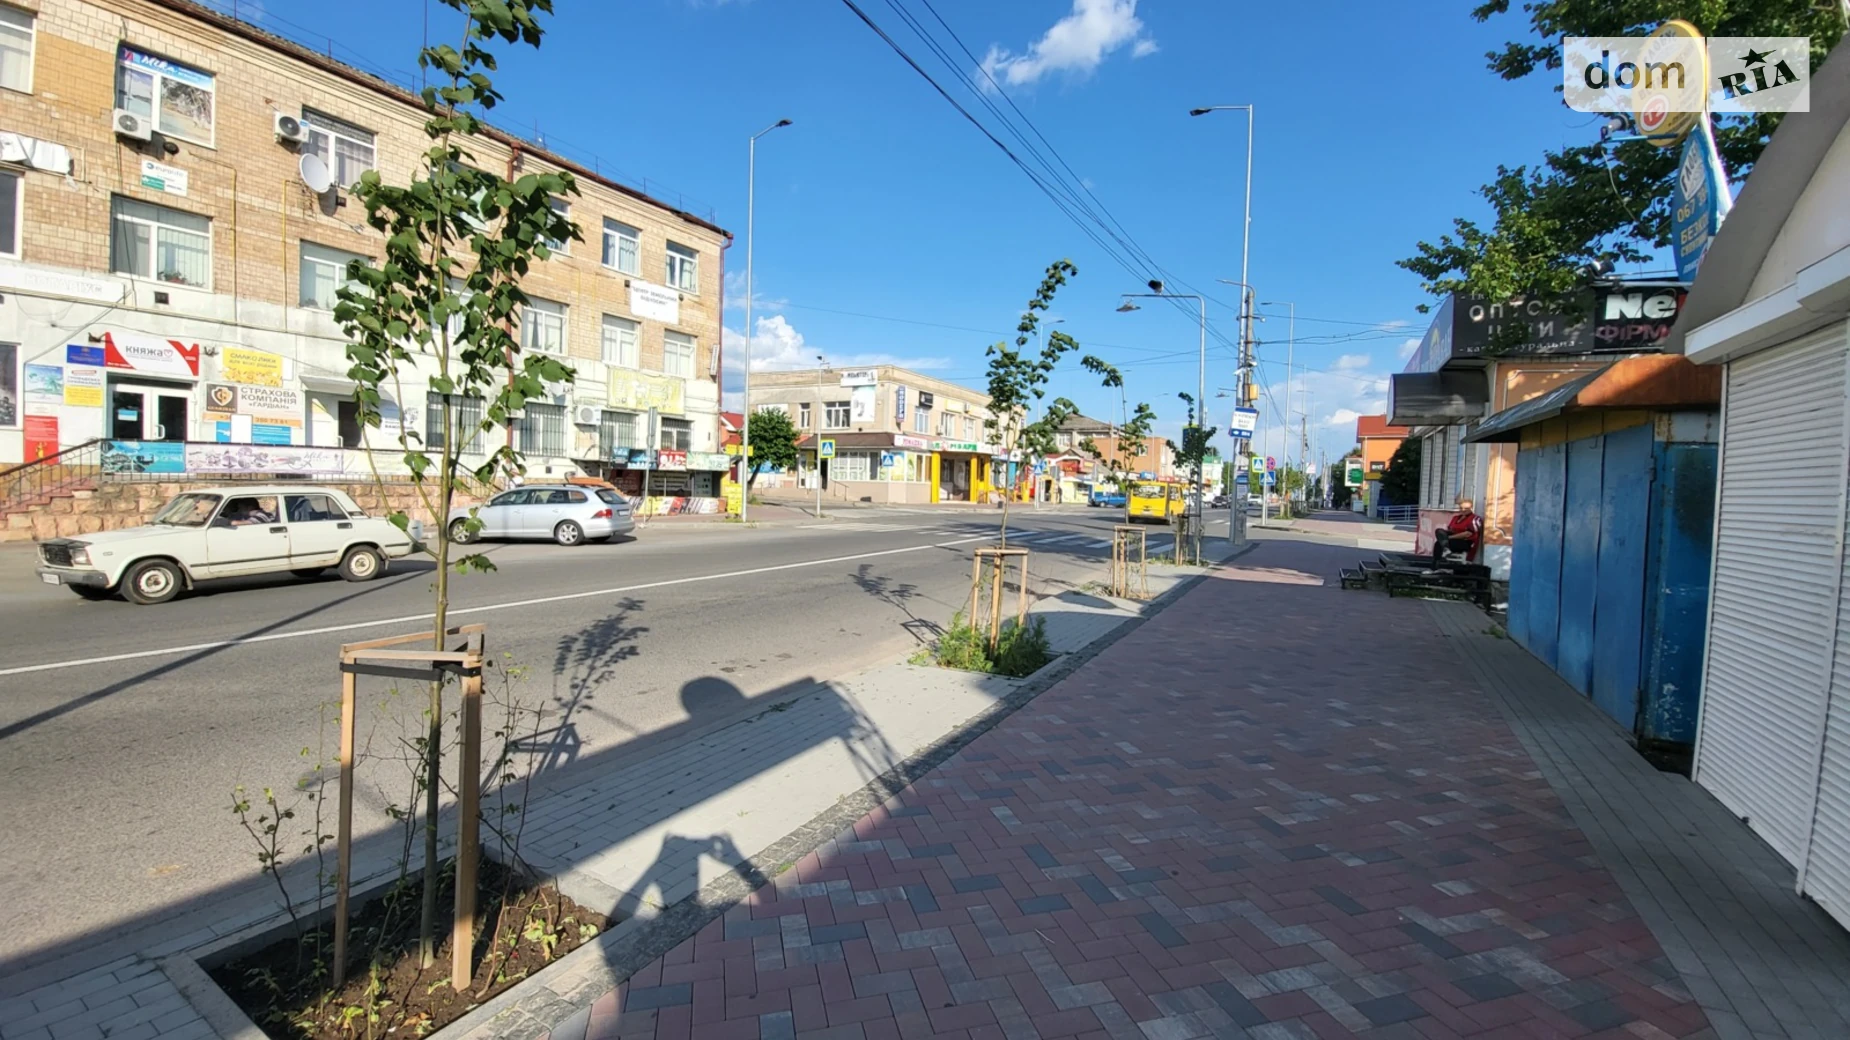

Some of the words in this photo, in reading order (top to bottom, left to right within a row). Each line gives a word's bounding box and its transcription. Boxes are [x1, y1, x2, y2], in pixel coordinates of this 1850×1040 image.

[1605, 292, 1687, 320] Ne
[240, 386, 297, 398] СТРАХОВА
[240, 394, 297, 405] КОМПАНІЯ
